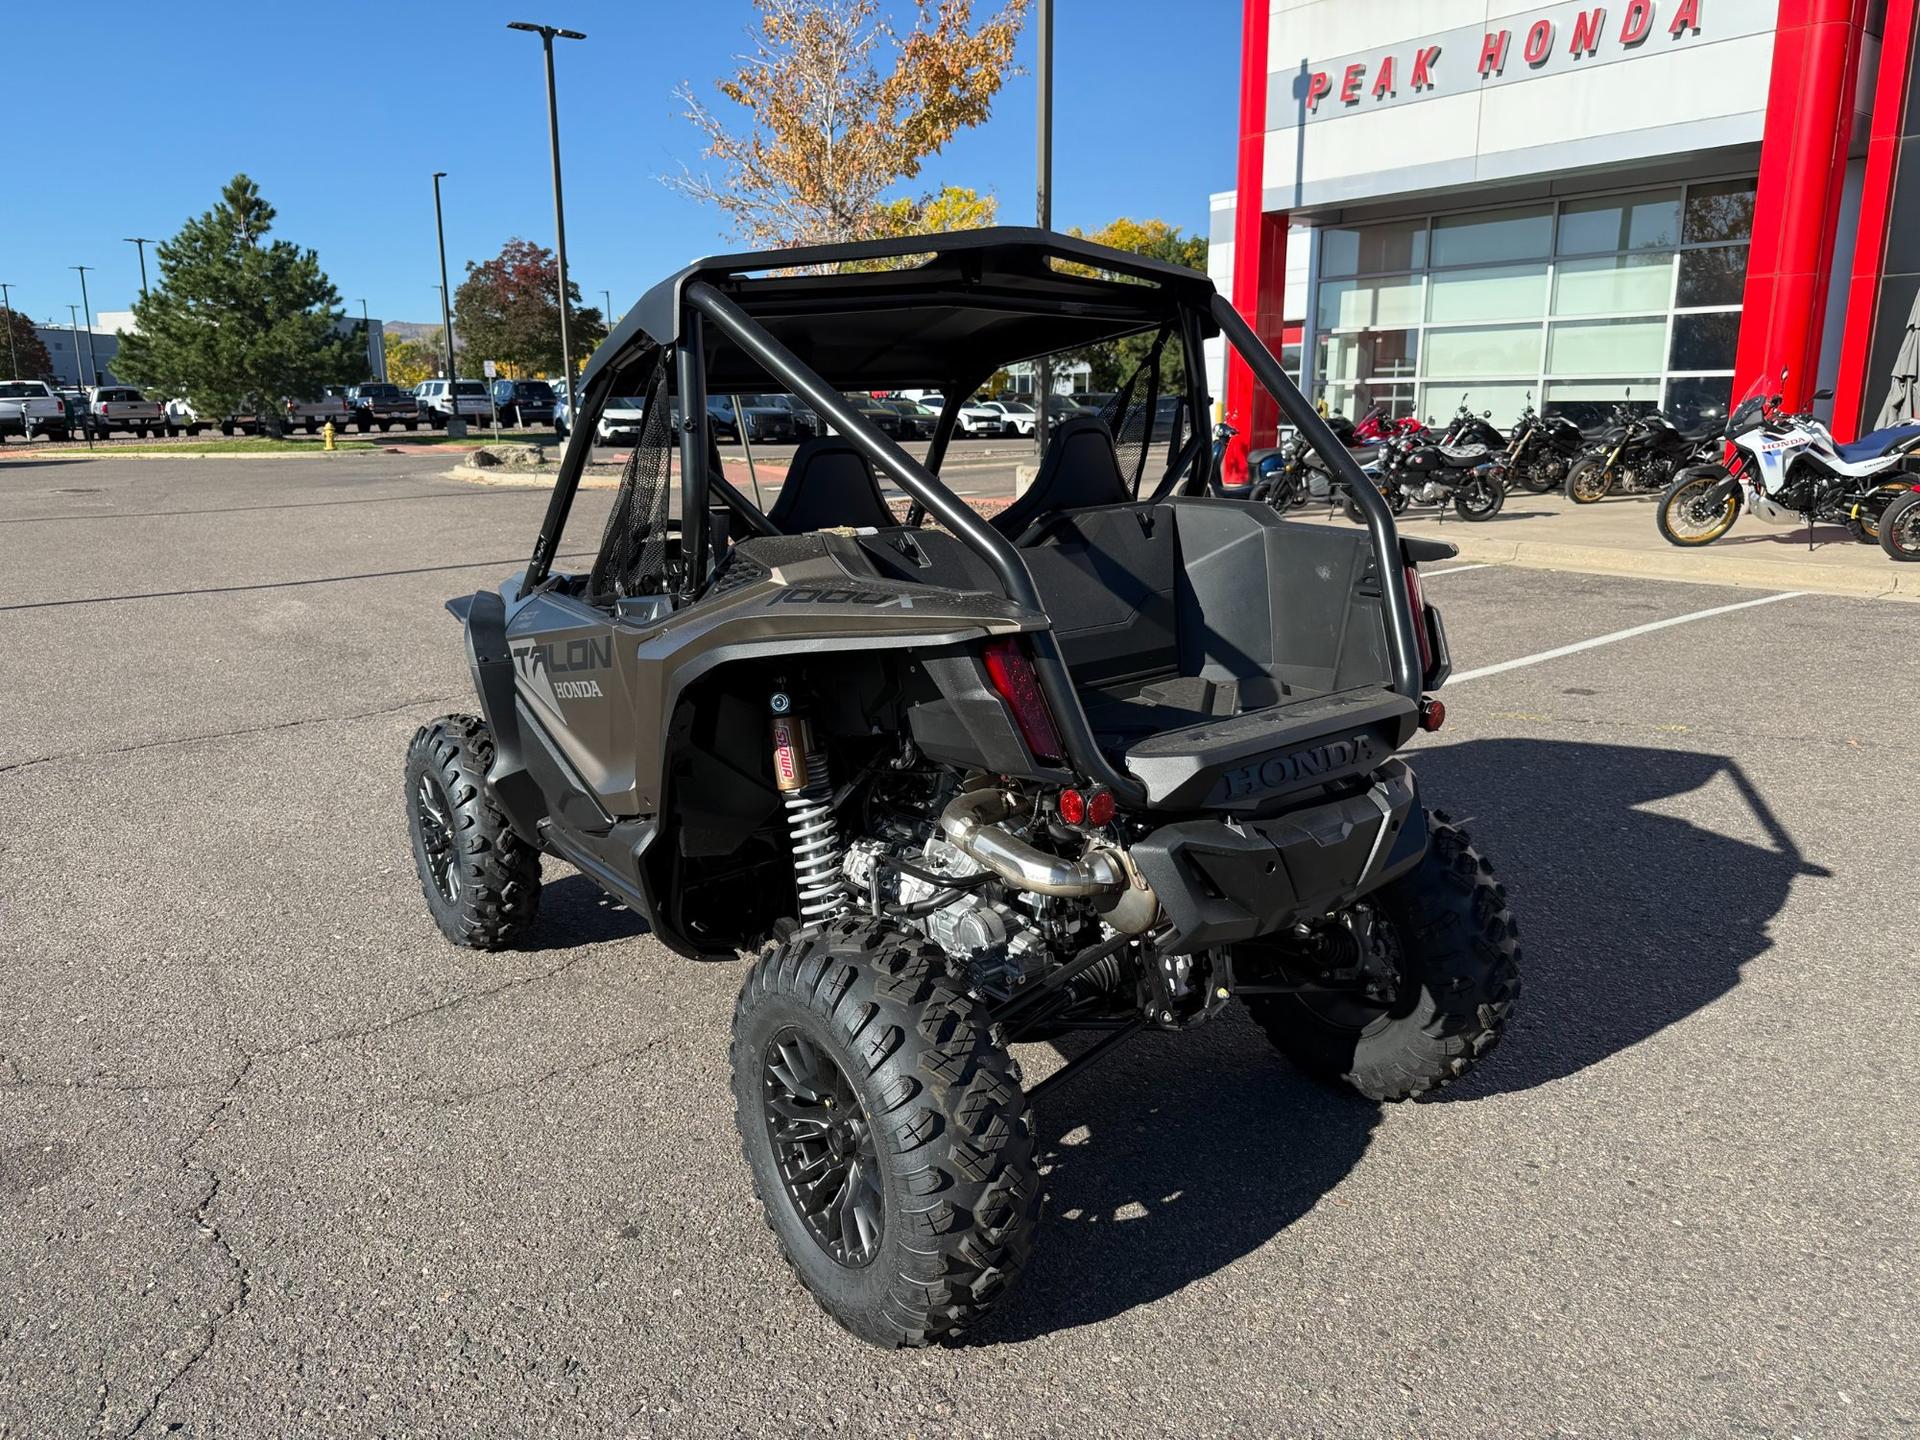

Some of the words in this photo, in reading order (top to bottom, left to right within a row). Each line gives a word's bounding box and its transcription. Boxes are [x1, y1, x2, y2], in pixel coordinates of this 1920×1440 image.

[1306, 45, 1441, 112] PEAK
[1477, 0, 1702, 79] HONDA
[1762, 438, 1806, 451] HONDA
[513, 635, 612, 679] TALON
[553, 680, 604, 699] HONDA
[775, 727, 794, 779] SHOWA
[1224, 734, 1376, 799] HONDA
